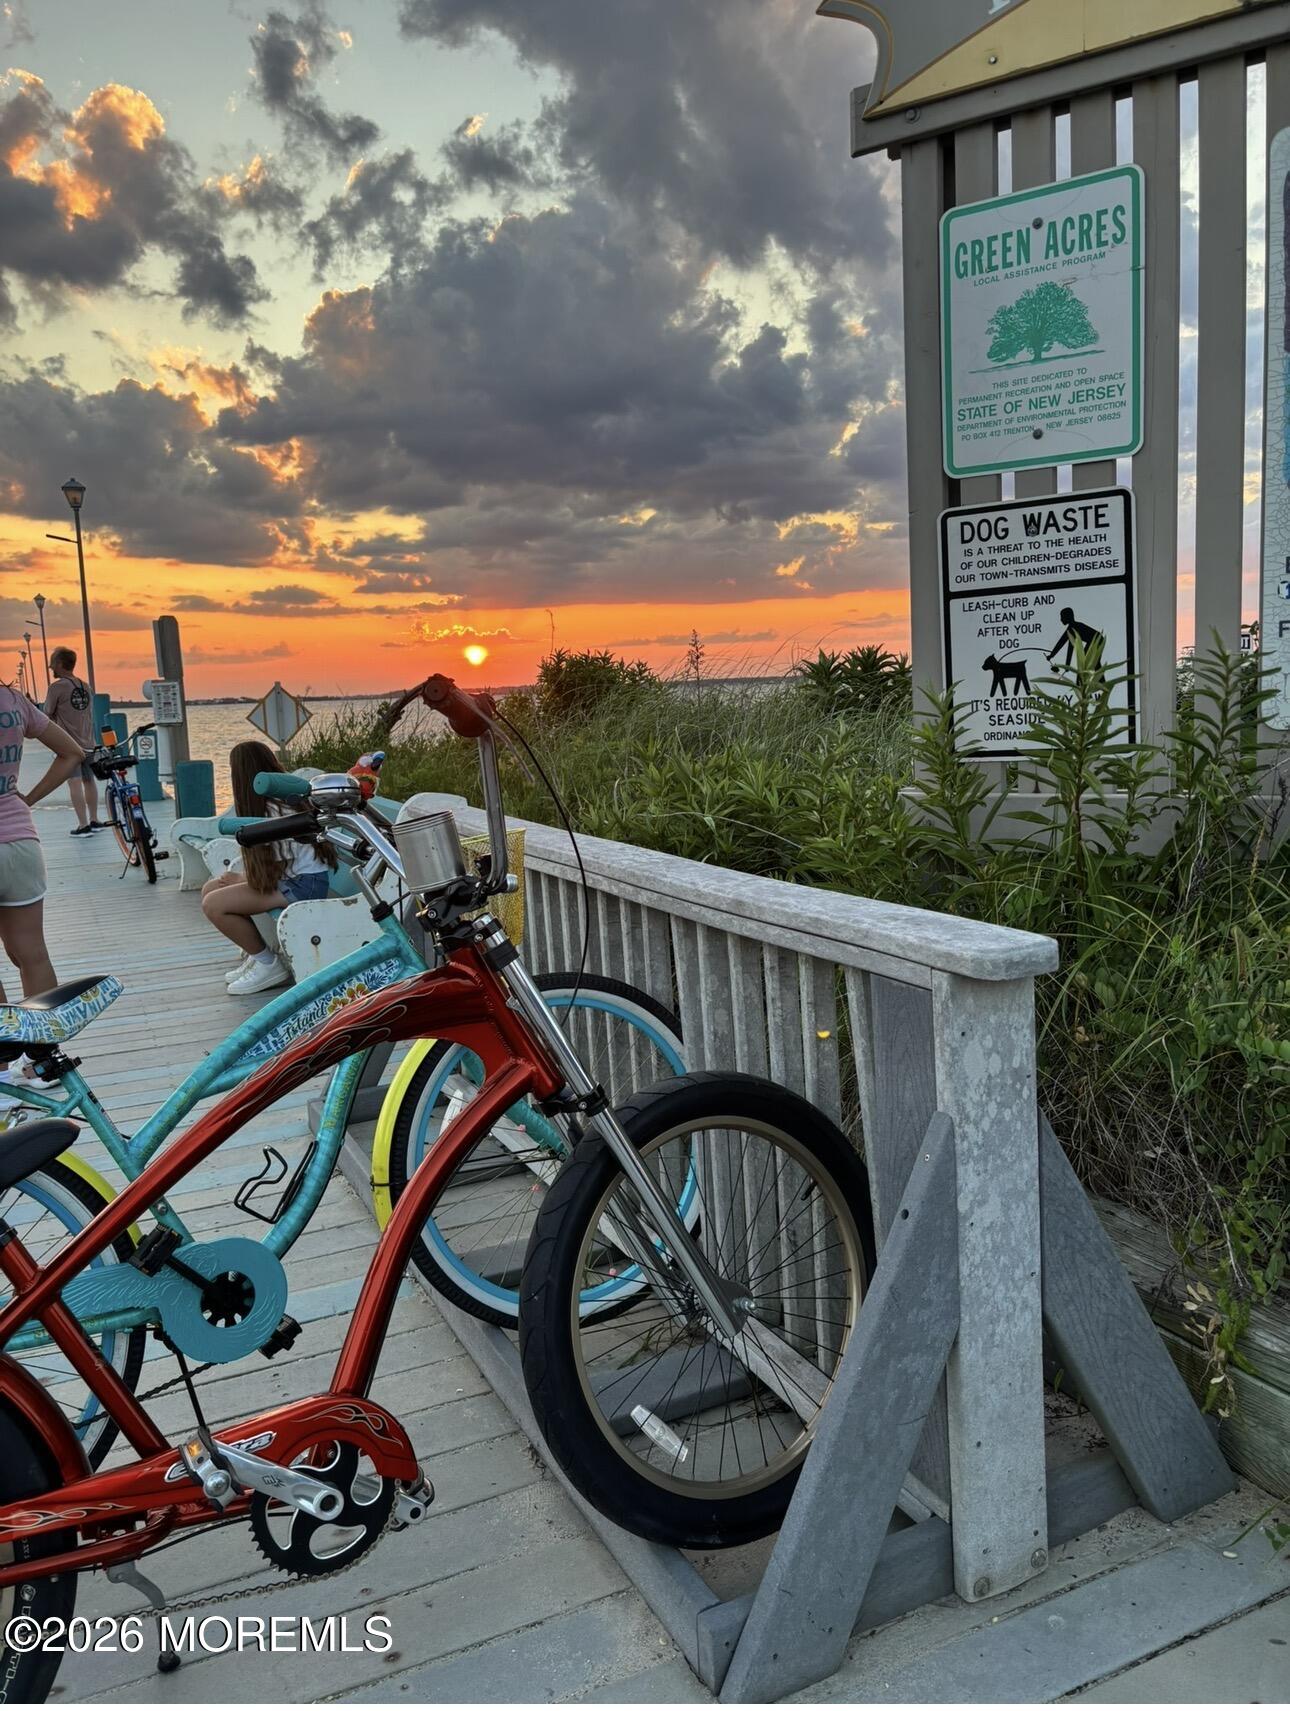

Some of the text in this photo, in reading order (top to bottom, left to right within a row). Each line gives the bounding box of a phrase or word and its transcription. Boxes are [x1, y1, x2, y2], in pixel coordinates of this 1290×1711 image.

[955, 204, 1127, 279] GREEN ACRES
[973, 251, 1106, 287] LOCAL ASSISTANCE PROGRAM
[958, 371, 1125, 405] PERMANENT RECREATION AND OPEN SPACE
[992, 367, 1087, 390] THIS SITE DEDICATED TO
[957, 383, 1126, 422] STATE OF NEW JERSEY
[957, 400, 1126, 432] DEPARTMENT OF ENVIRONMENTAL PROTECTION
[973, 432, 987, 440] BOX
[1046, 421, 1062, 430] NEW
[1065, 416, 1093, 427] JERSEY
[960, 504, 1110, 544] DOG WASTE
[963, 533, 1107, 557] IS A THREAT TO THE HEALTH
[960, 546, 1112, 570] OF OUR CHILDREN-DEGRADES
[955, 559, 1119, 584] OUR TOWN-TRANSMITS DISEASE
[962, 594, 1055, 612] LEASH-CURB AND
[983, 610, 1035, 624] CLEAN UP
[977, 623, 1042, 638] AFTER YOUR
[999, 638, 1020, 649] DOG
[971, 699, 990, 713] IT'S
